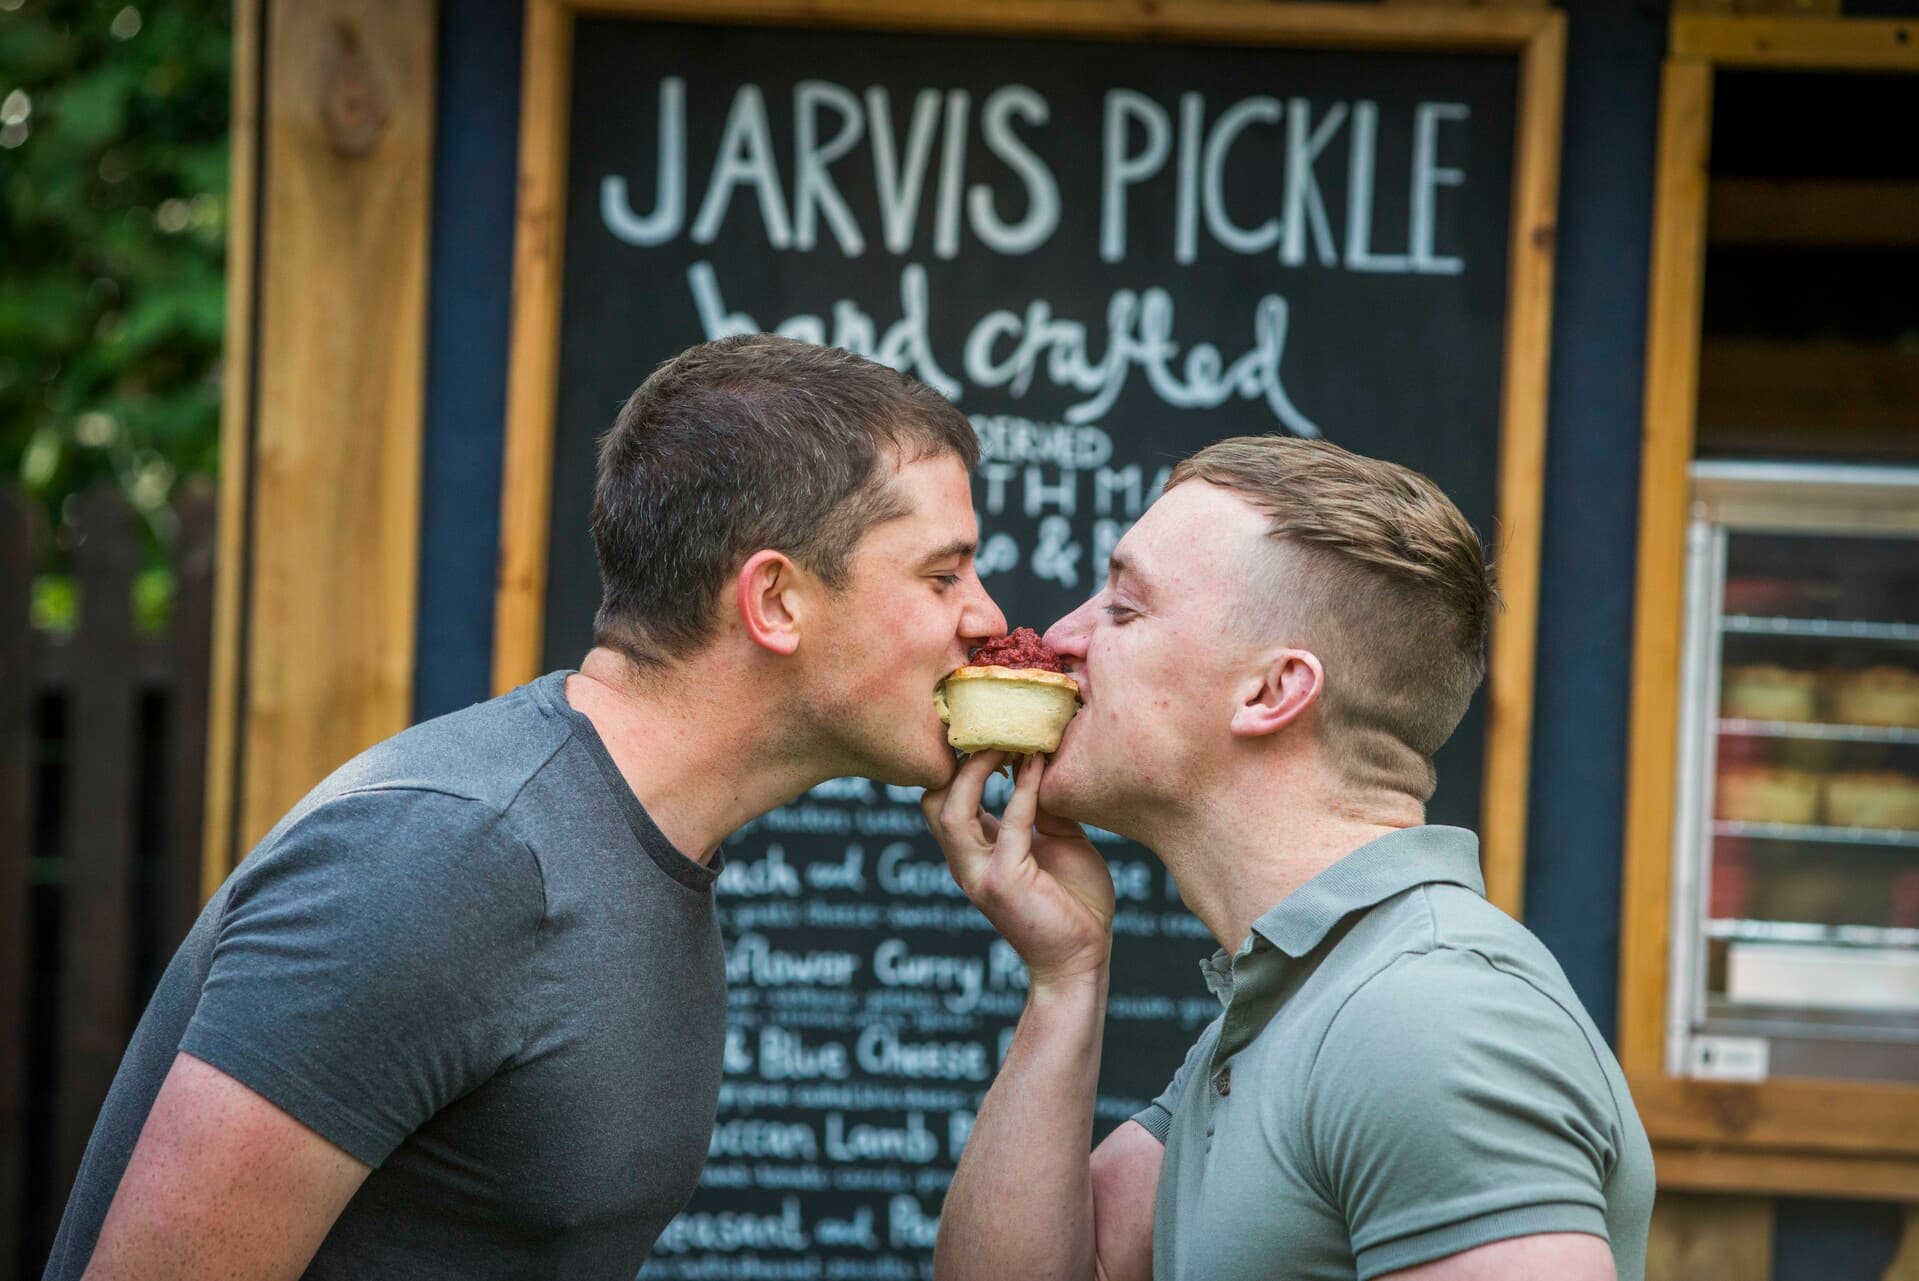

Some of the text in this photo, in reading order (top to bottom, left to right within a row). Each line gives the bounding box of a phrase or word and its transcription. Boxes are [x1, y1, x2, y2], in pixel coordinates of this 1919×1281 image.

[601, 76, 1470, 274] JARVIS PICKLE
[963, 286, 1321, 438] crafted
[873, 938, 984, 1014] Curry
[759, 1024, 849, 1080] Blue
[856, 1022, 990, 1081] Cheese
[825, 1111, 938, 1163] Lamb
